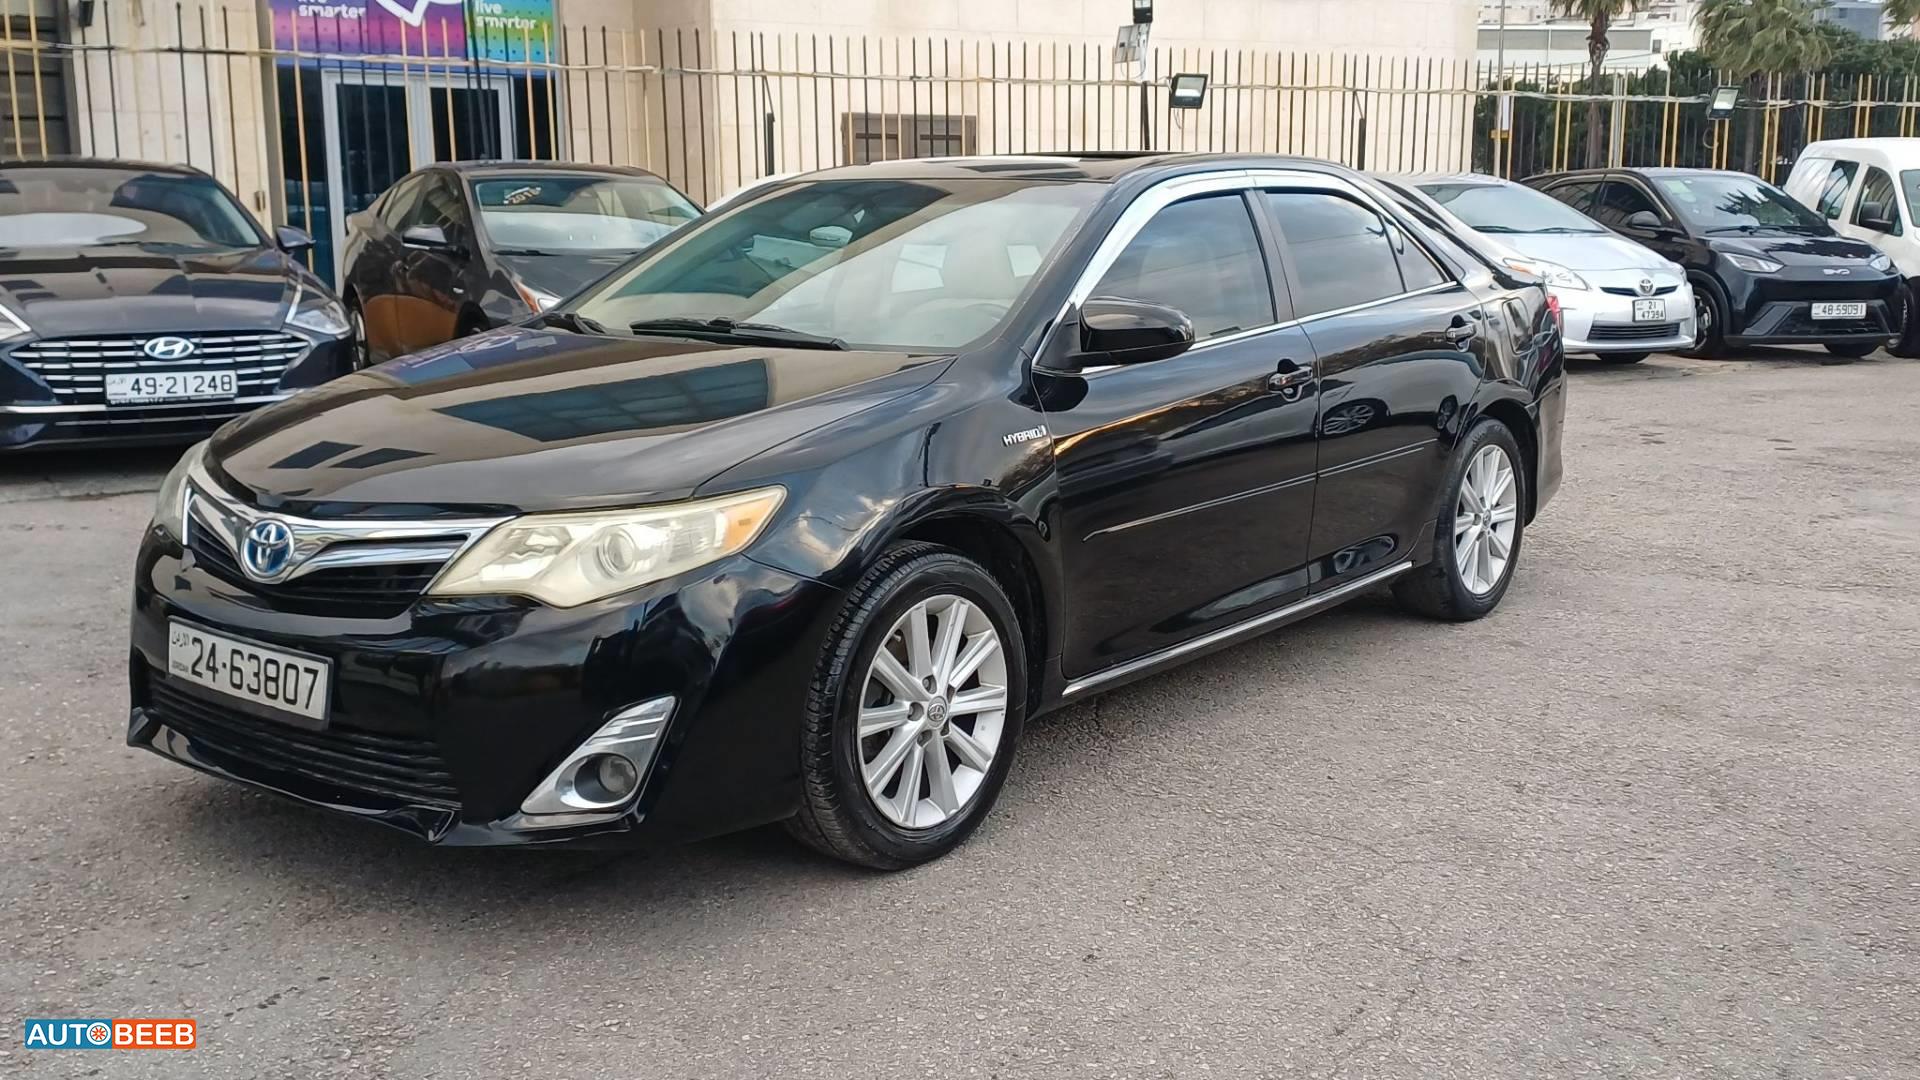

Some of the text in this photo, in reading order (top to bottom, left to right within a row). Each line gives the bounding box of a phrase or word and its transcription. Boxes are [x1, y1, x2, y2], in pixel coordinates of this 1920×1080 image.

[298, 4, 367, 18] smarter
[475, 0, 503, 14] live
[130, 374, 233, 396] 49-21248
[190, 636, 320, 710] 24-63807
